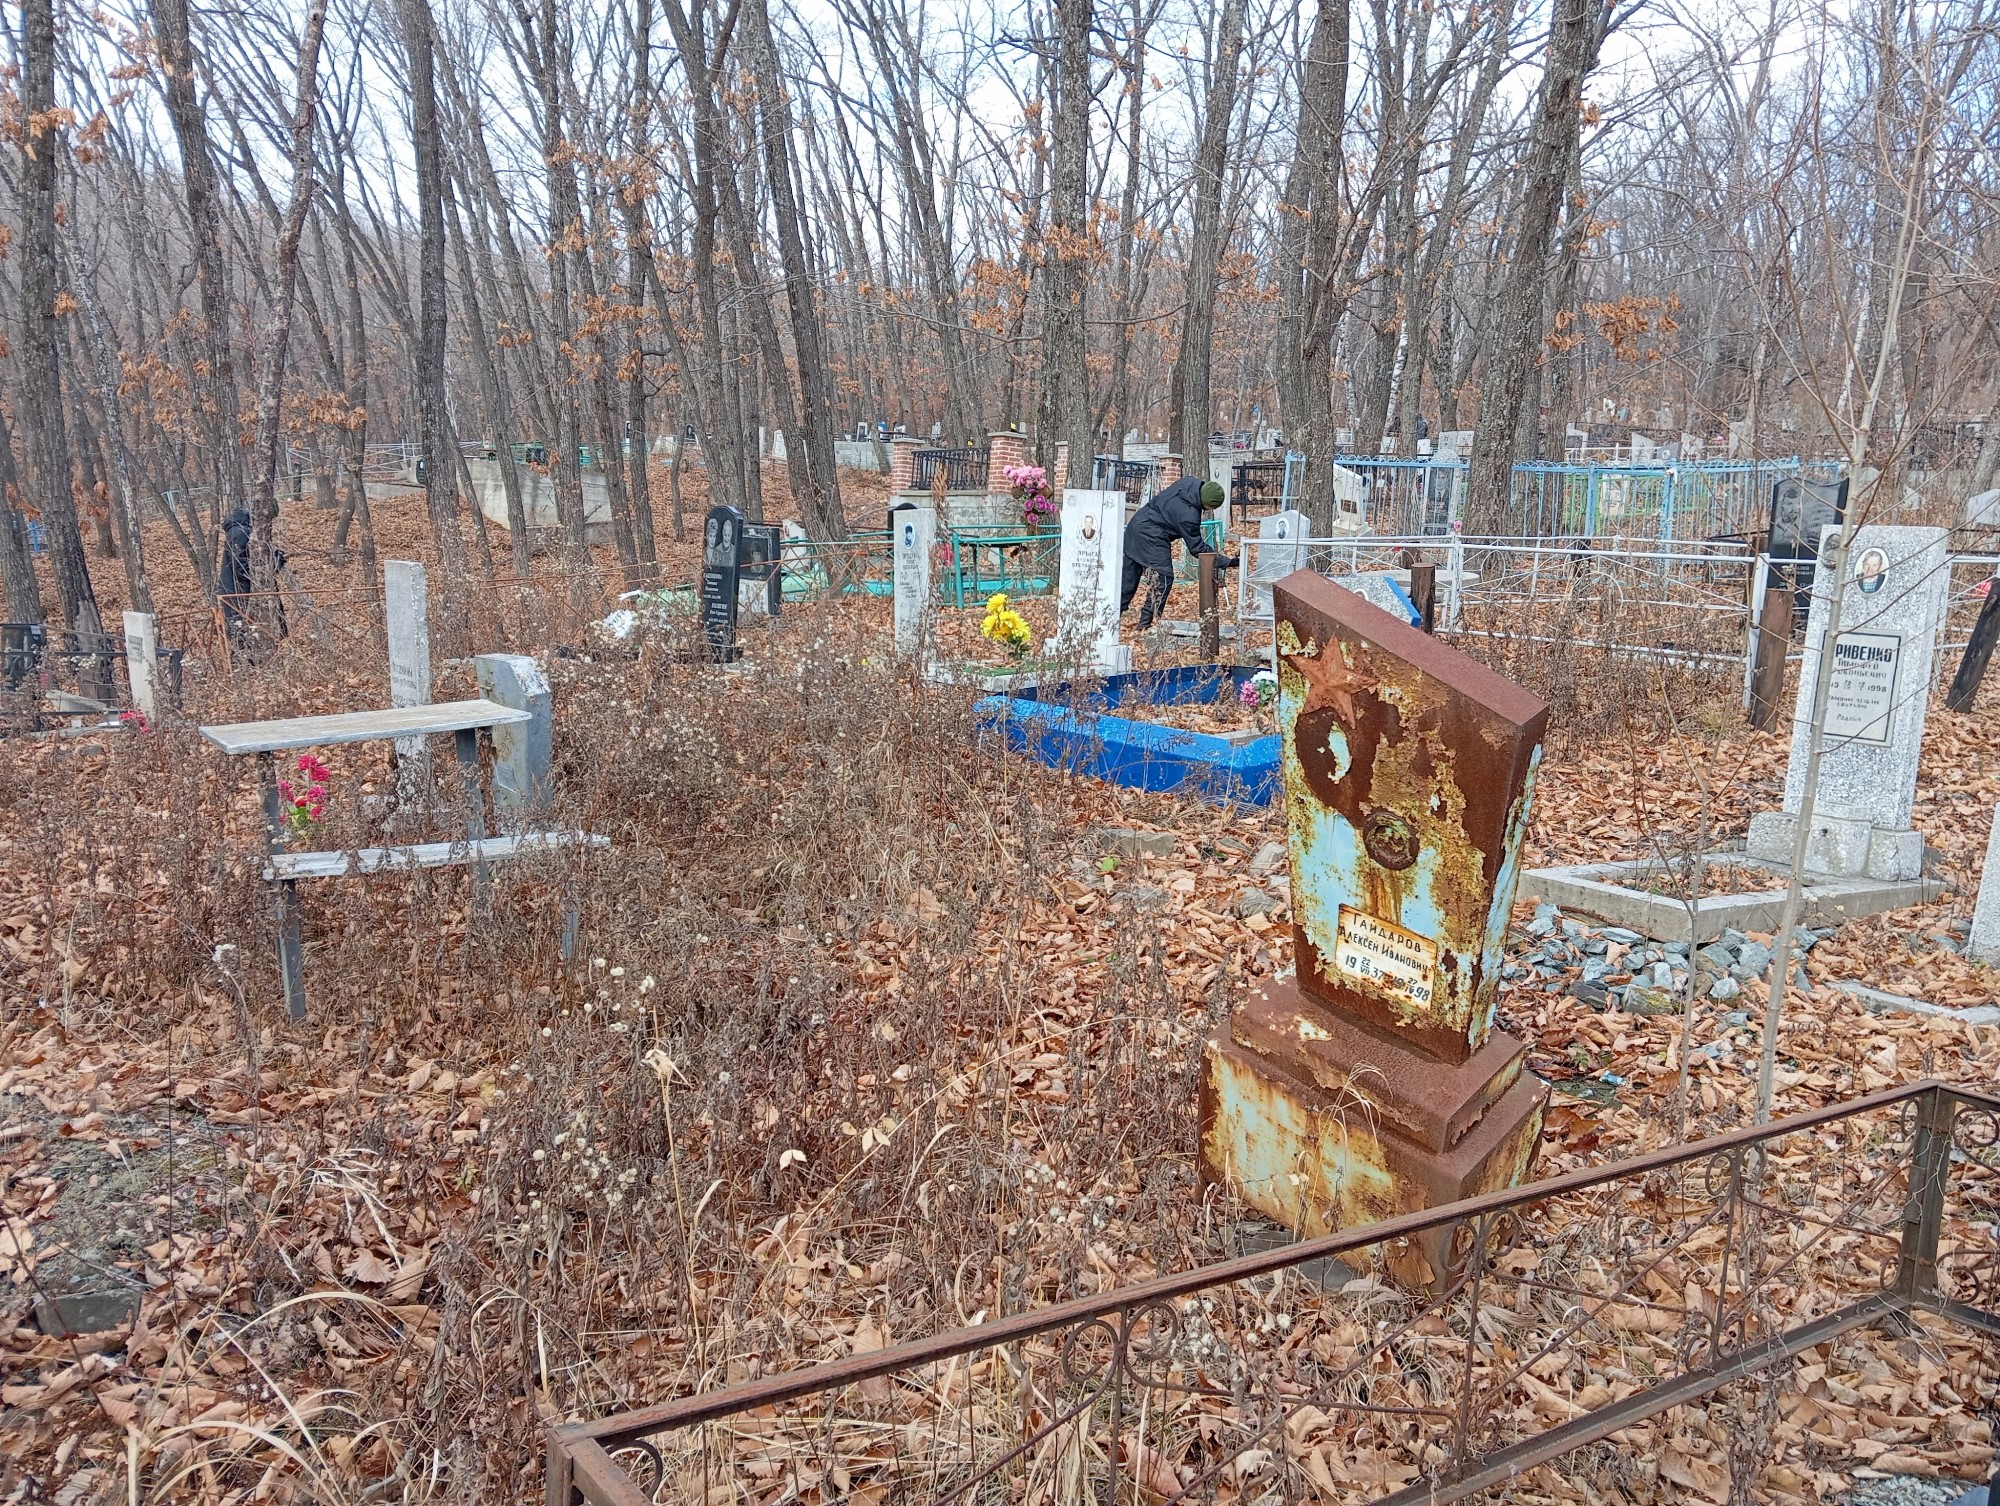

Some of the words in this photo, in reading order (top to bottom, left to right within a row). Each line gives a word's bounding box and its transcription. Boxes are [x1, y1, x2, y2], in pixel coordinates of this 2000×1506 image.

[1835, 643, 1893, 662] РИВЕНКО
[1345, 955, 1357, 969] 19
[1361, 956, 1371, 967] 22
[1371, 967, 1385, 981] 37
[1414, 987, 1431, 1002] 98
